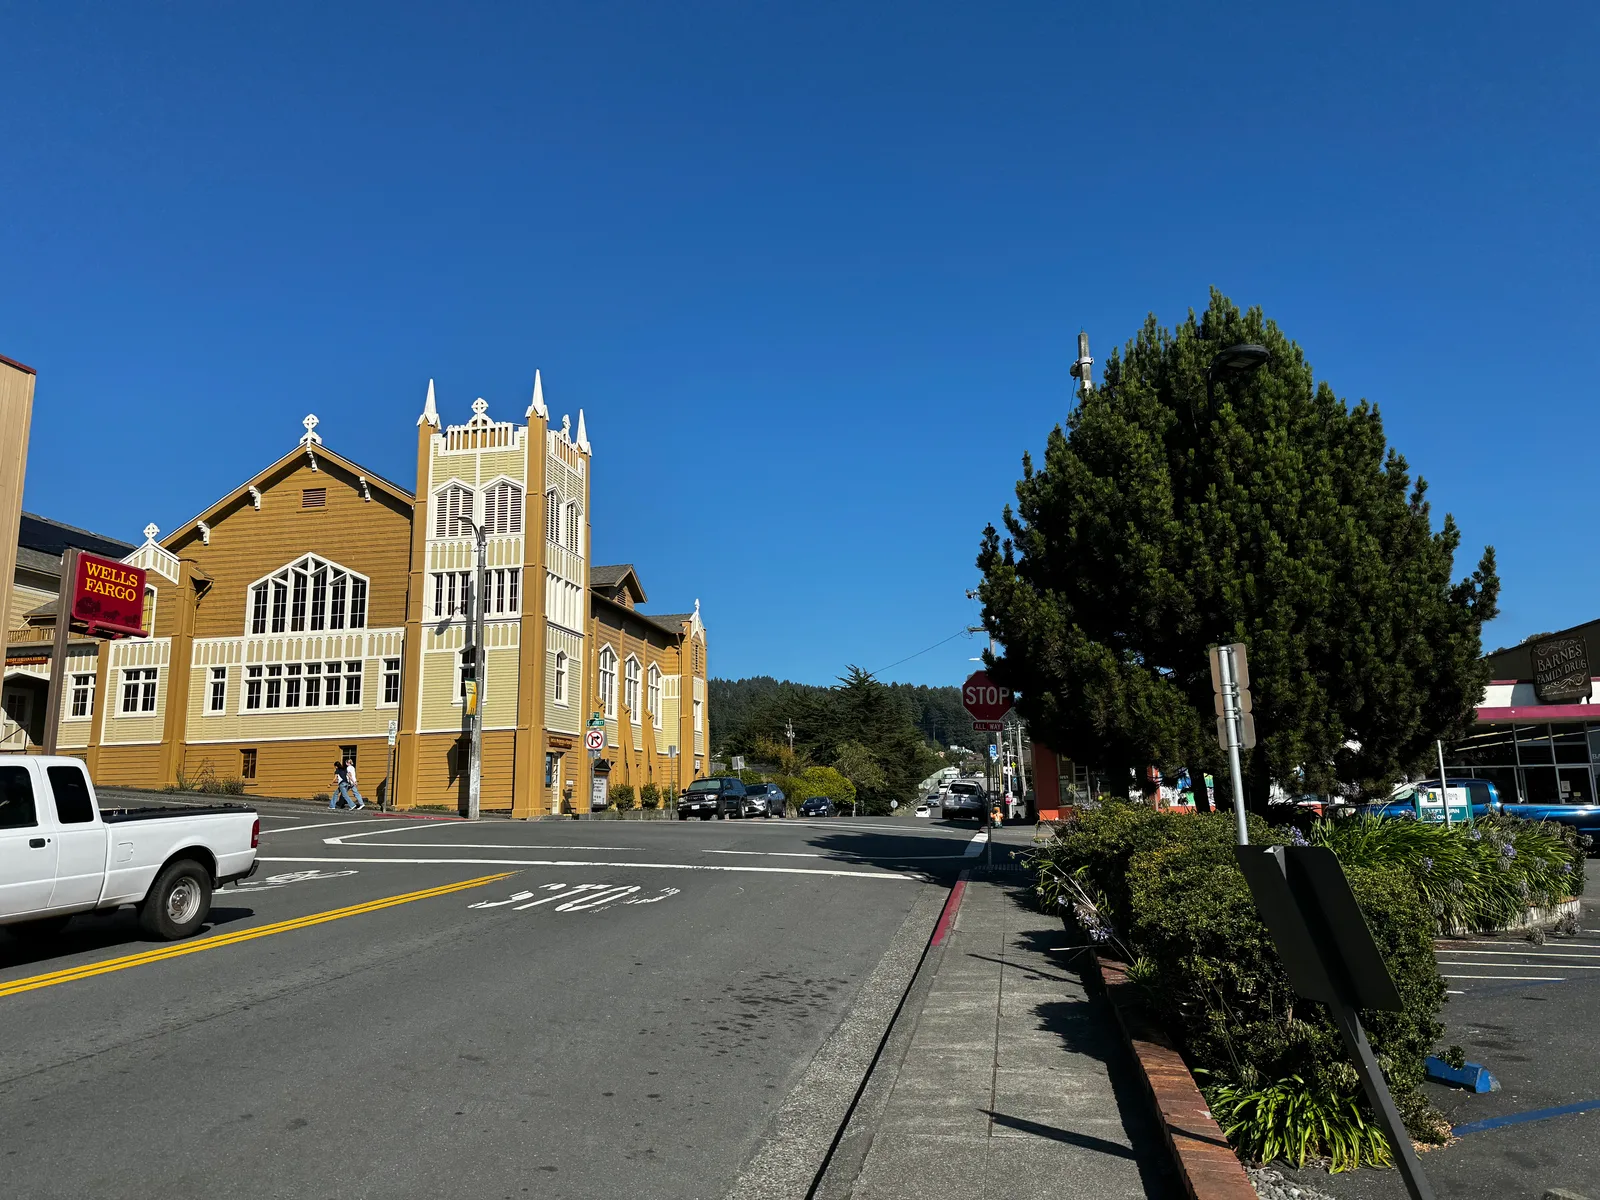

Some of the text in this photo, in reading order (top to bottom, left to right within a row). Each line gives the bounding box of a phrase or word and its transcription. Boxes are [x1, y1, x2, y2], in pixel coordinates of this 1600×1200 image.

[85, 561, 139, 588] WELLS
[84, 577, 137, 602] FARGO
[1537, 644, 1583, 672] BARNES
[1537, 660, 1586, 683] FAMILY DRUG
[966, 686, 1009, 705] STOP
